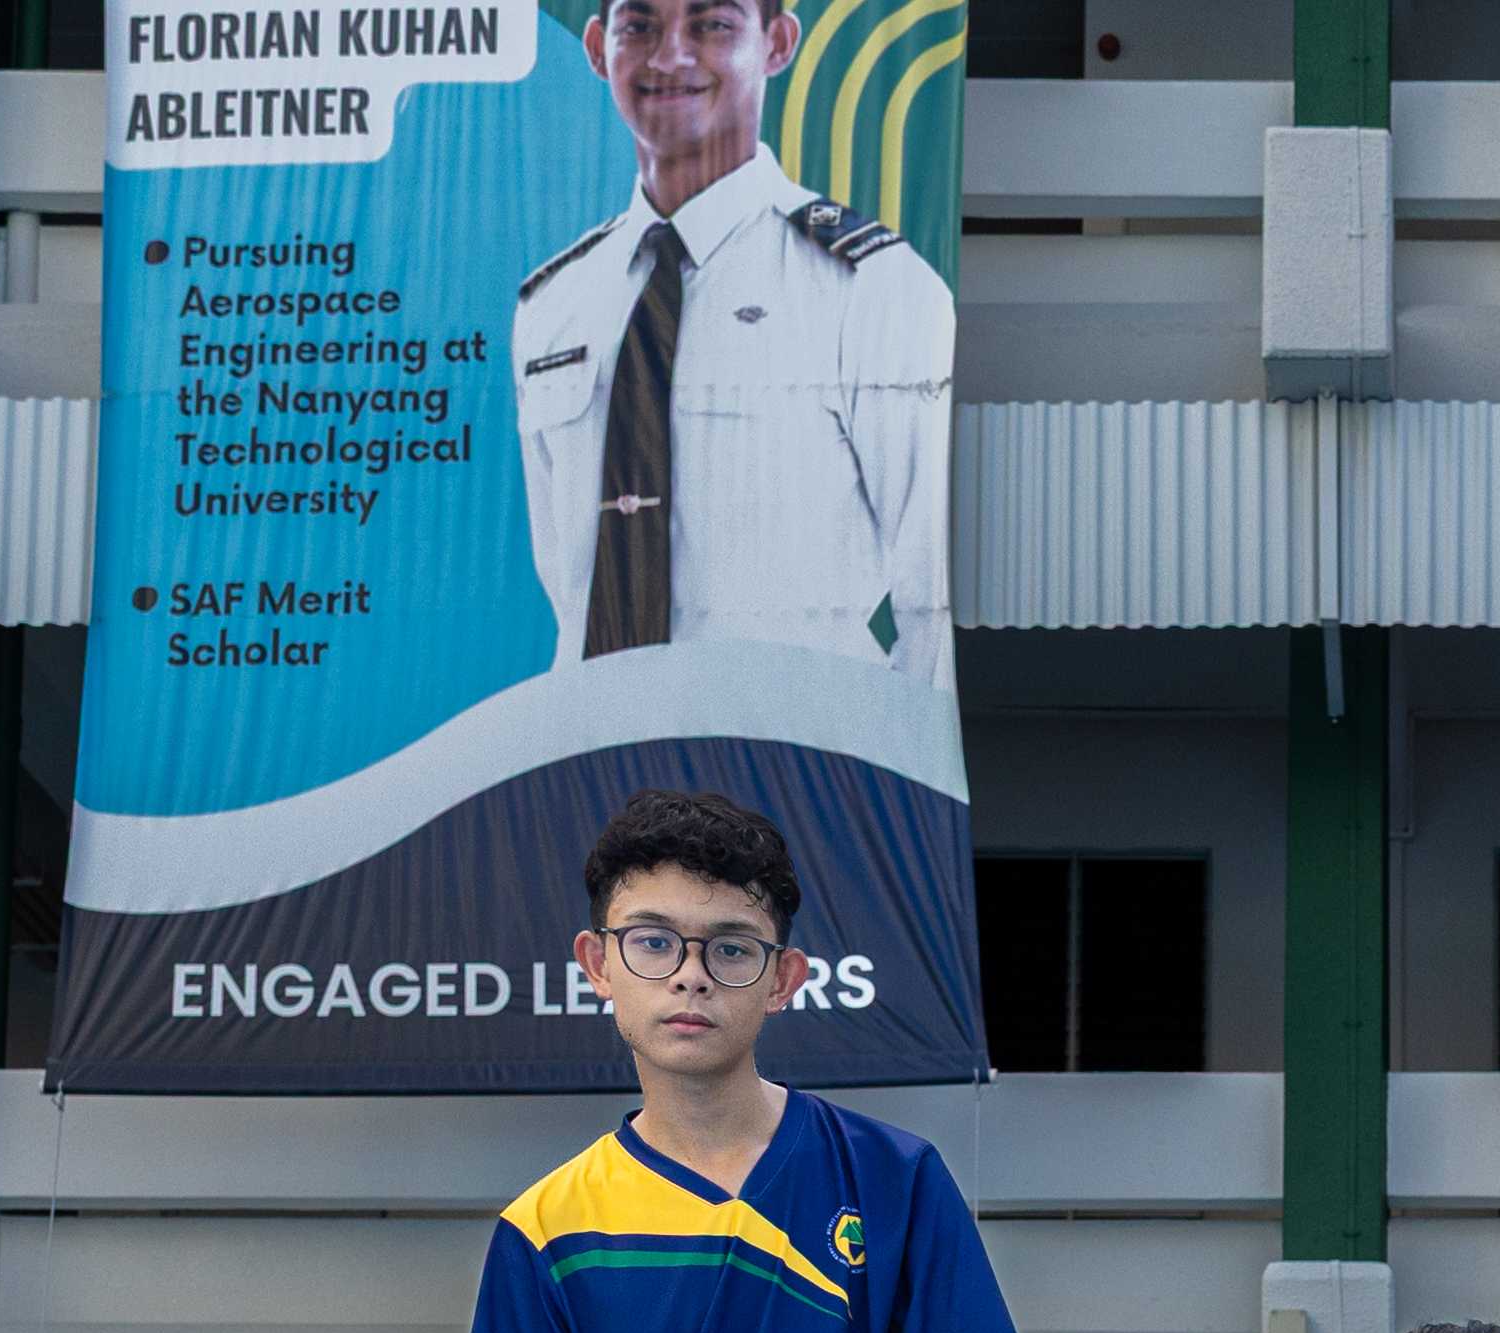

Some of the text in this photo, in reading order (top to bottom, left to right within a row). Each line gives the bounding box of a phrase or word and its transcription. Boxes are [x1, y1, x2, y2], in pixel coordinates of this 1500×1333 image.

[129, 7, 498, 64] FLORIAN KUHAN
[125, 87, 370, 143] ABLEITNER
[183, 233, 356, 278] Pursuing
[179, 284, 401, 327] Aerospace
[179, 330, 428, 379] Engineering
[443, 331, 487, 363] at
[177, 378, 449, 426] the Nanyang
[174, 423, 472, 475] Technological
[174, 479, 380, 526] University
[170, 580, 372, 617] SAF Merit
[167, 627, 329, 667] Scholar
[171, 953, 876, 1017] ENGAGED LERS
